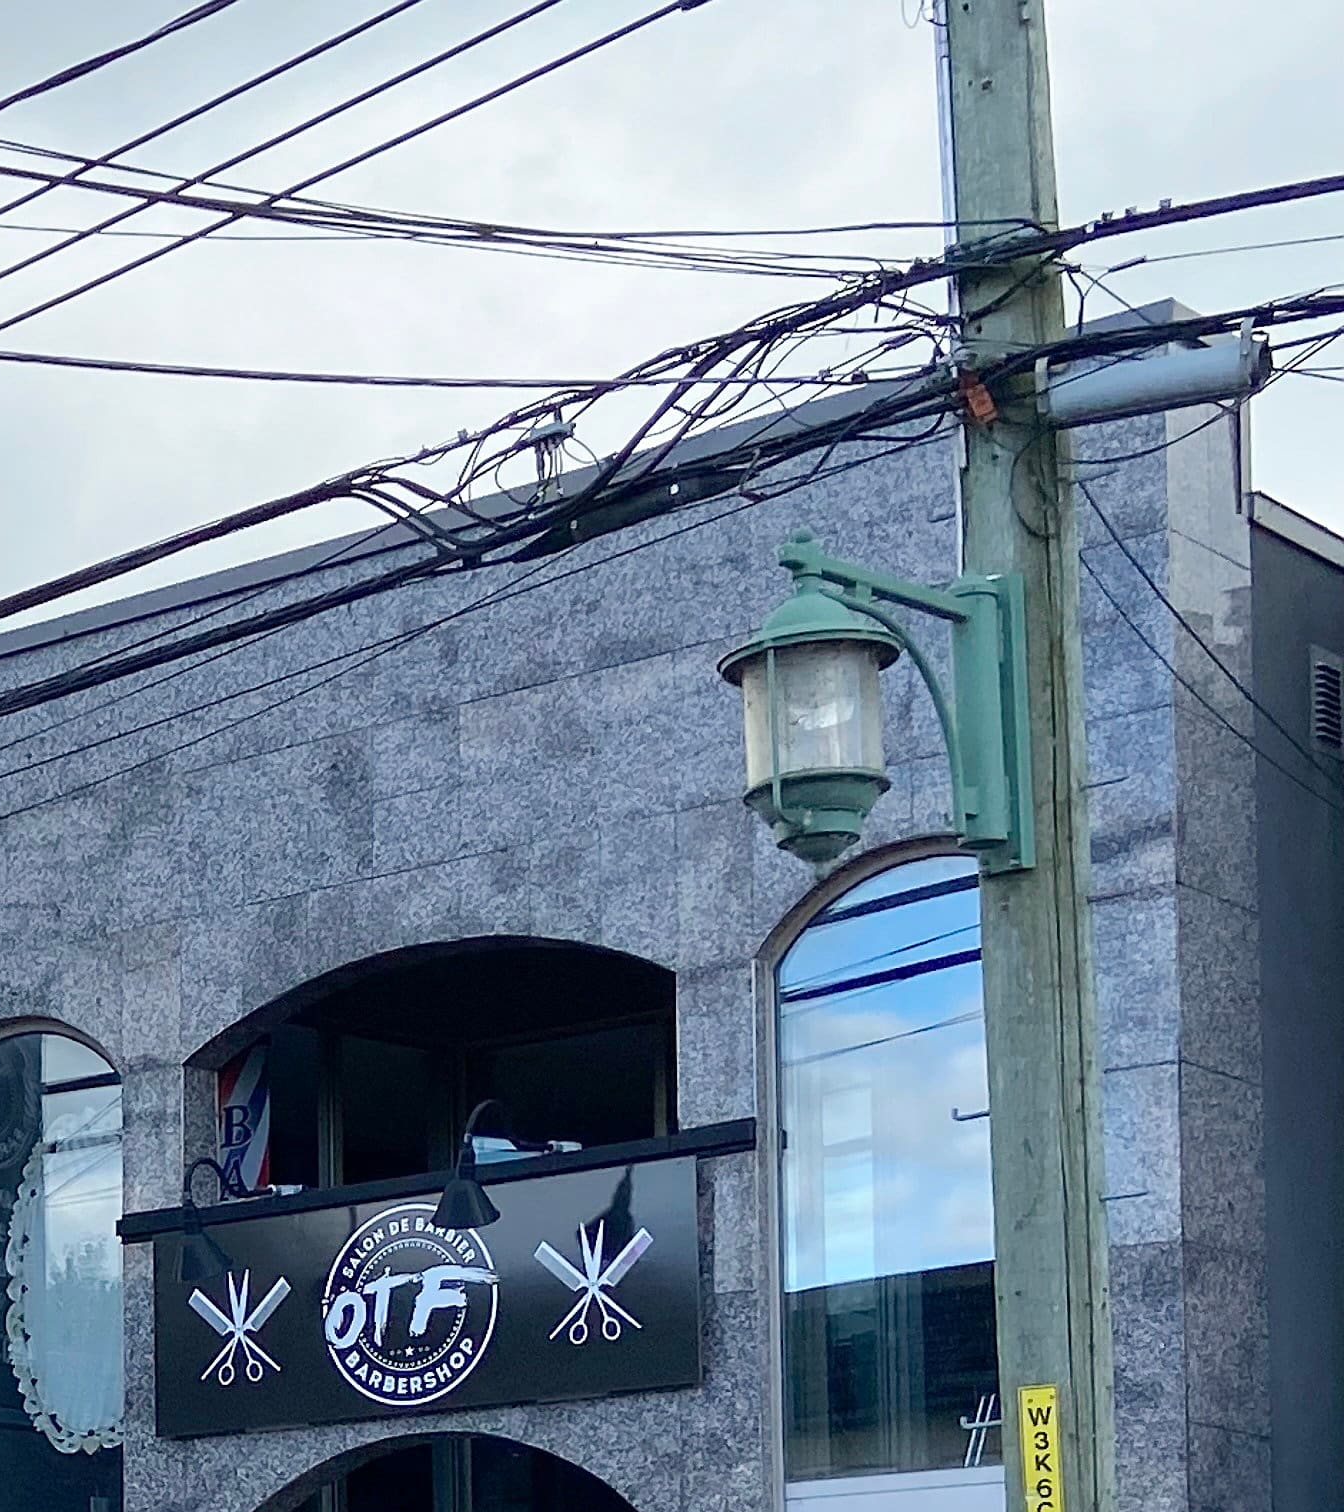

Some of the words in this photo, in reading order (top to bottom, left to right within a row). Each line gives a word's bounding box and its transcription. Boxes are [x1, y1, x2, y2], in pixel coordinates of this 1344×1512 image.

[342, 1228, 386, 1279] SALON
[388, 1217, 410, 1236] DE
[325, 1265, 499, 1350] OTF
[345, 1337, 474, 1395] BARBERSHOP
